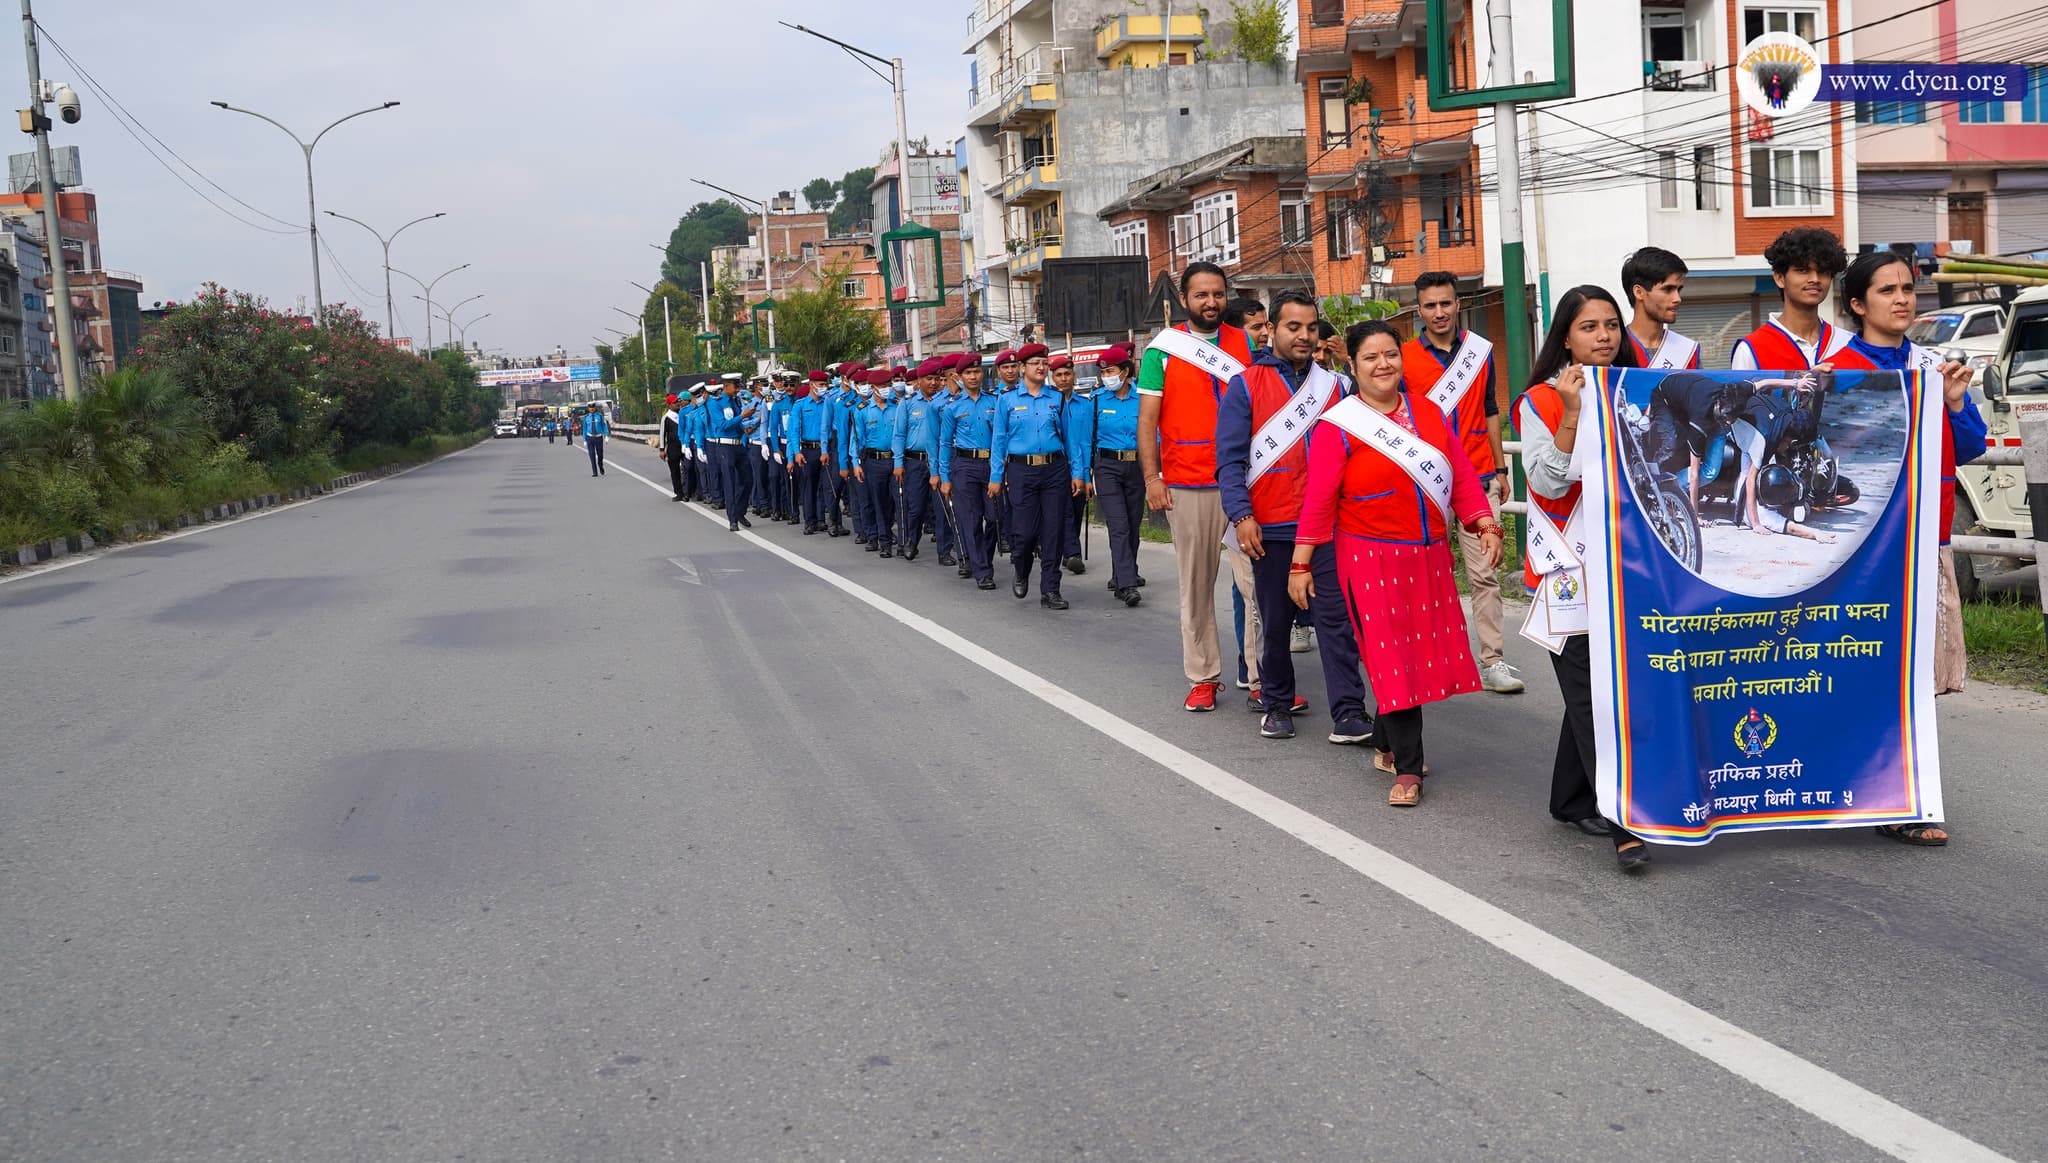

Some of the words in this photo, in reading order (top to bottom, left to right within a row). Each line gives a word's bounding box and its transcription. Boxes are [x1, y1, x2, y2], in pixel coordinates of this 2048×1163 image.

[935, 184, 958, 193] WOR
[1639, 606, 1777, 635] मोटरसाईकलमा
[1776, 601, 1803, 636] दुई
[1805, 604, 1840, 621] जना
[1845, 603, 1890, 622] भन्दा
[1647, 648, 1687, 673] बढी
[1688, 649, 1726, 669] यात्रा
[1785, 637, 1821, 661] तिब्र
[1825, 634, 1884, 658] गतिमा
[1693, 676, 1738, 704] सवारी
[1708, 762, 1763, 790] ट्राफिक
[1765, 758, 1804, 780] प्रहरी
[1714, 794, 1759, 813] मध्यपुर
[1764, 788, 1797, 807] थिमी
